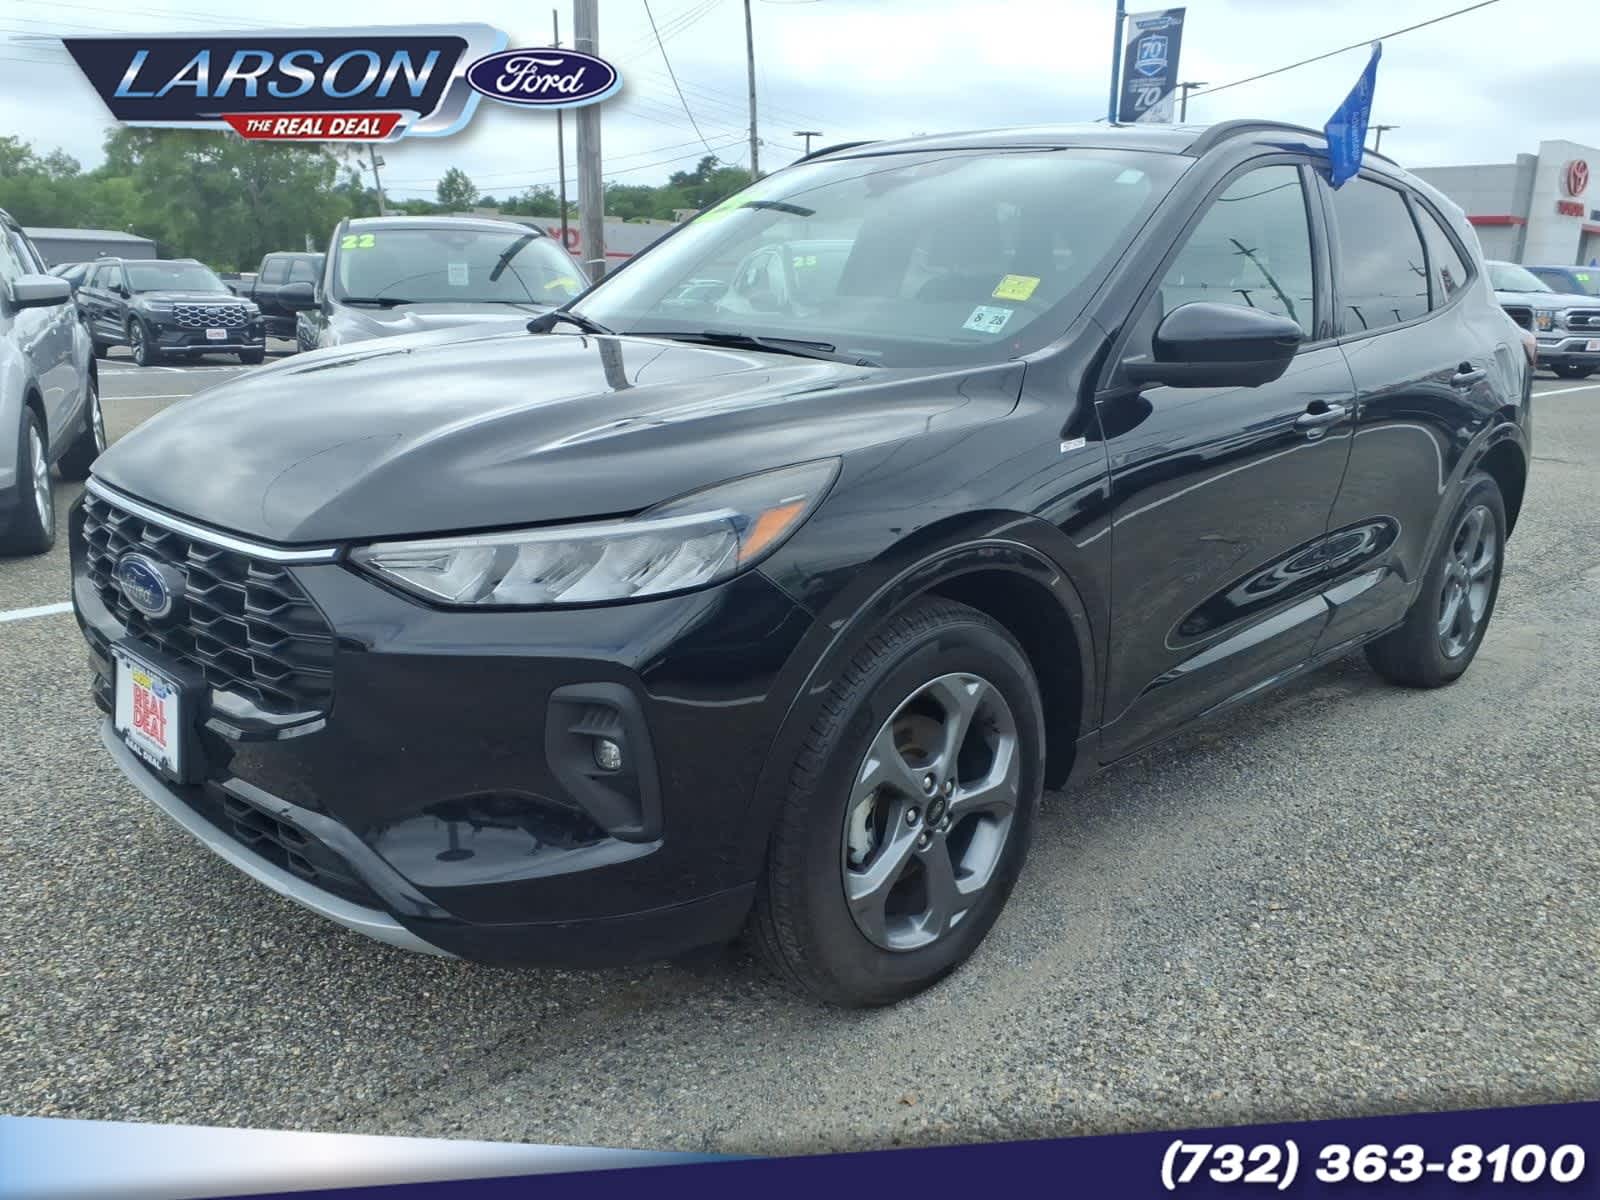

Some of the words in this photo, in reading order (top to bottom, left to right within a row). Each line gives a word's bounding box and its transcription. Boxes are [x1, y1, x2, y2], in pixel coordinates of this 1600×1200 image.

[1141, 42, 1162, 59] 70
[1134, 87, 1161, 108] 70
[342, 234, 376, 249] 22
[132, 683, 167, 724] REAL
[132, 704, 168, 749] DEAL
